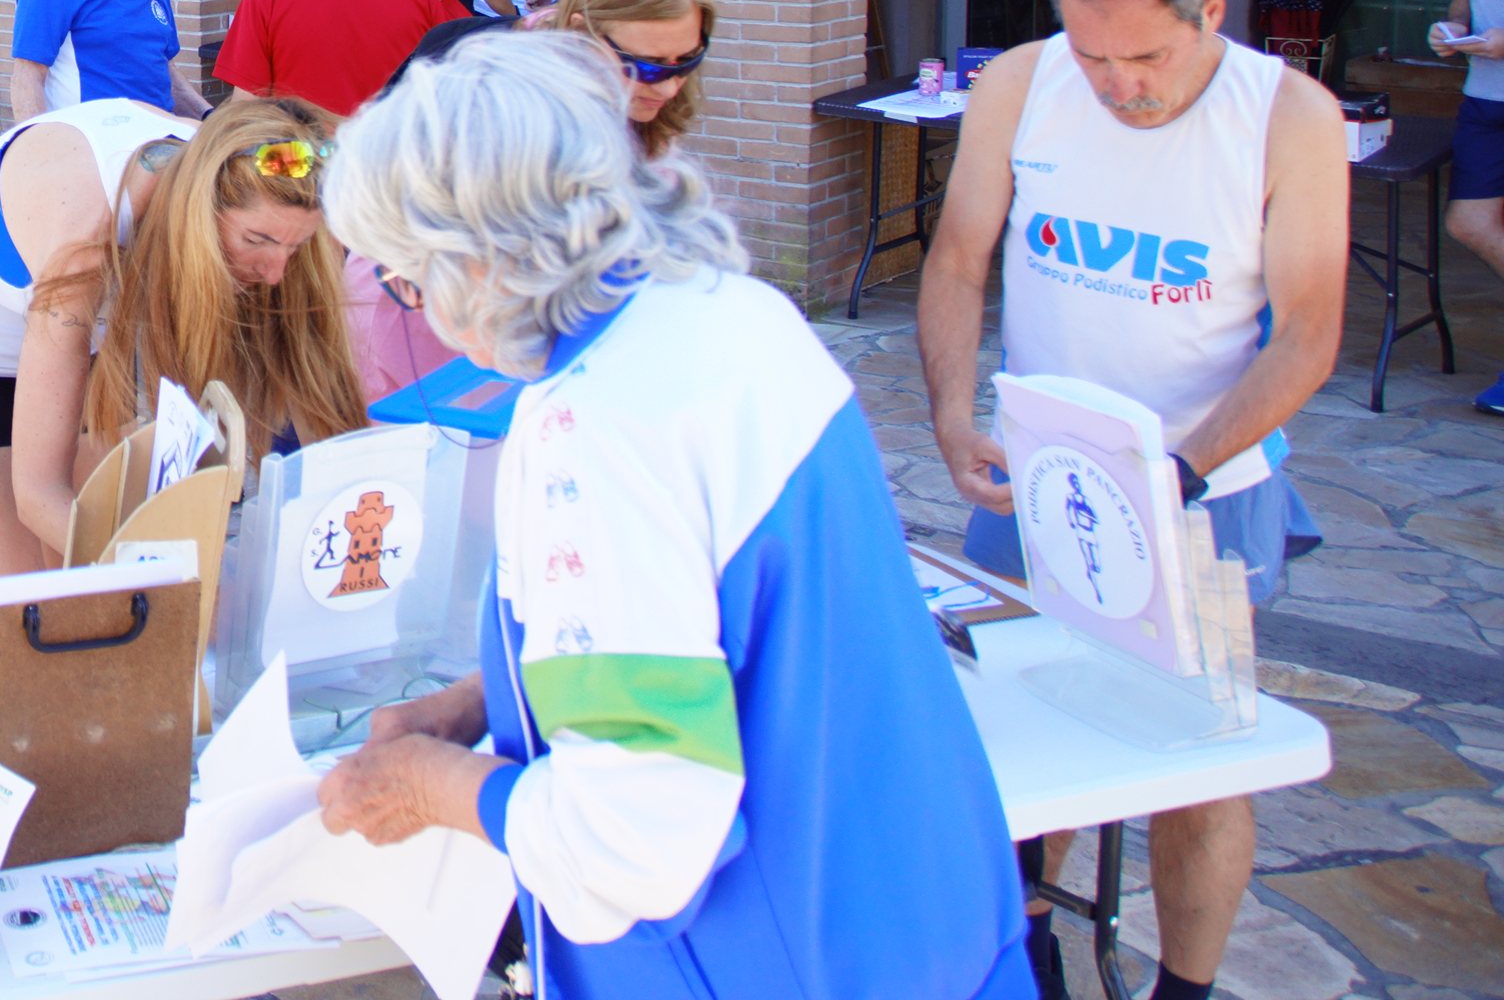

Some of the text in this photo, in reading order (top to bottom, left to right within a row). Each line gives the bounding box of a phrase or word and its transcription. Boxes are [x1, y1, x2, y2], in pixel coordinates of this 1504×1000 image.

[1025, 212, 1210, 287] AVIS
[1026, 255, 1213, 305] Gruppo Podistico Forlì
[339, 578, 379, 593] RUSSI
